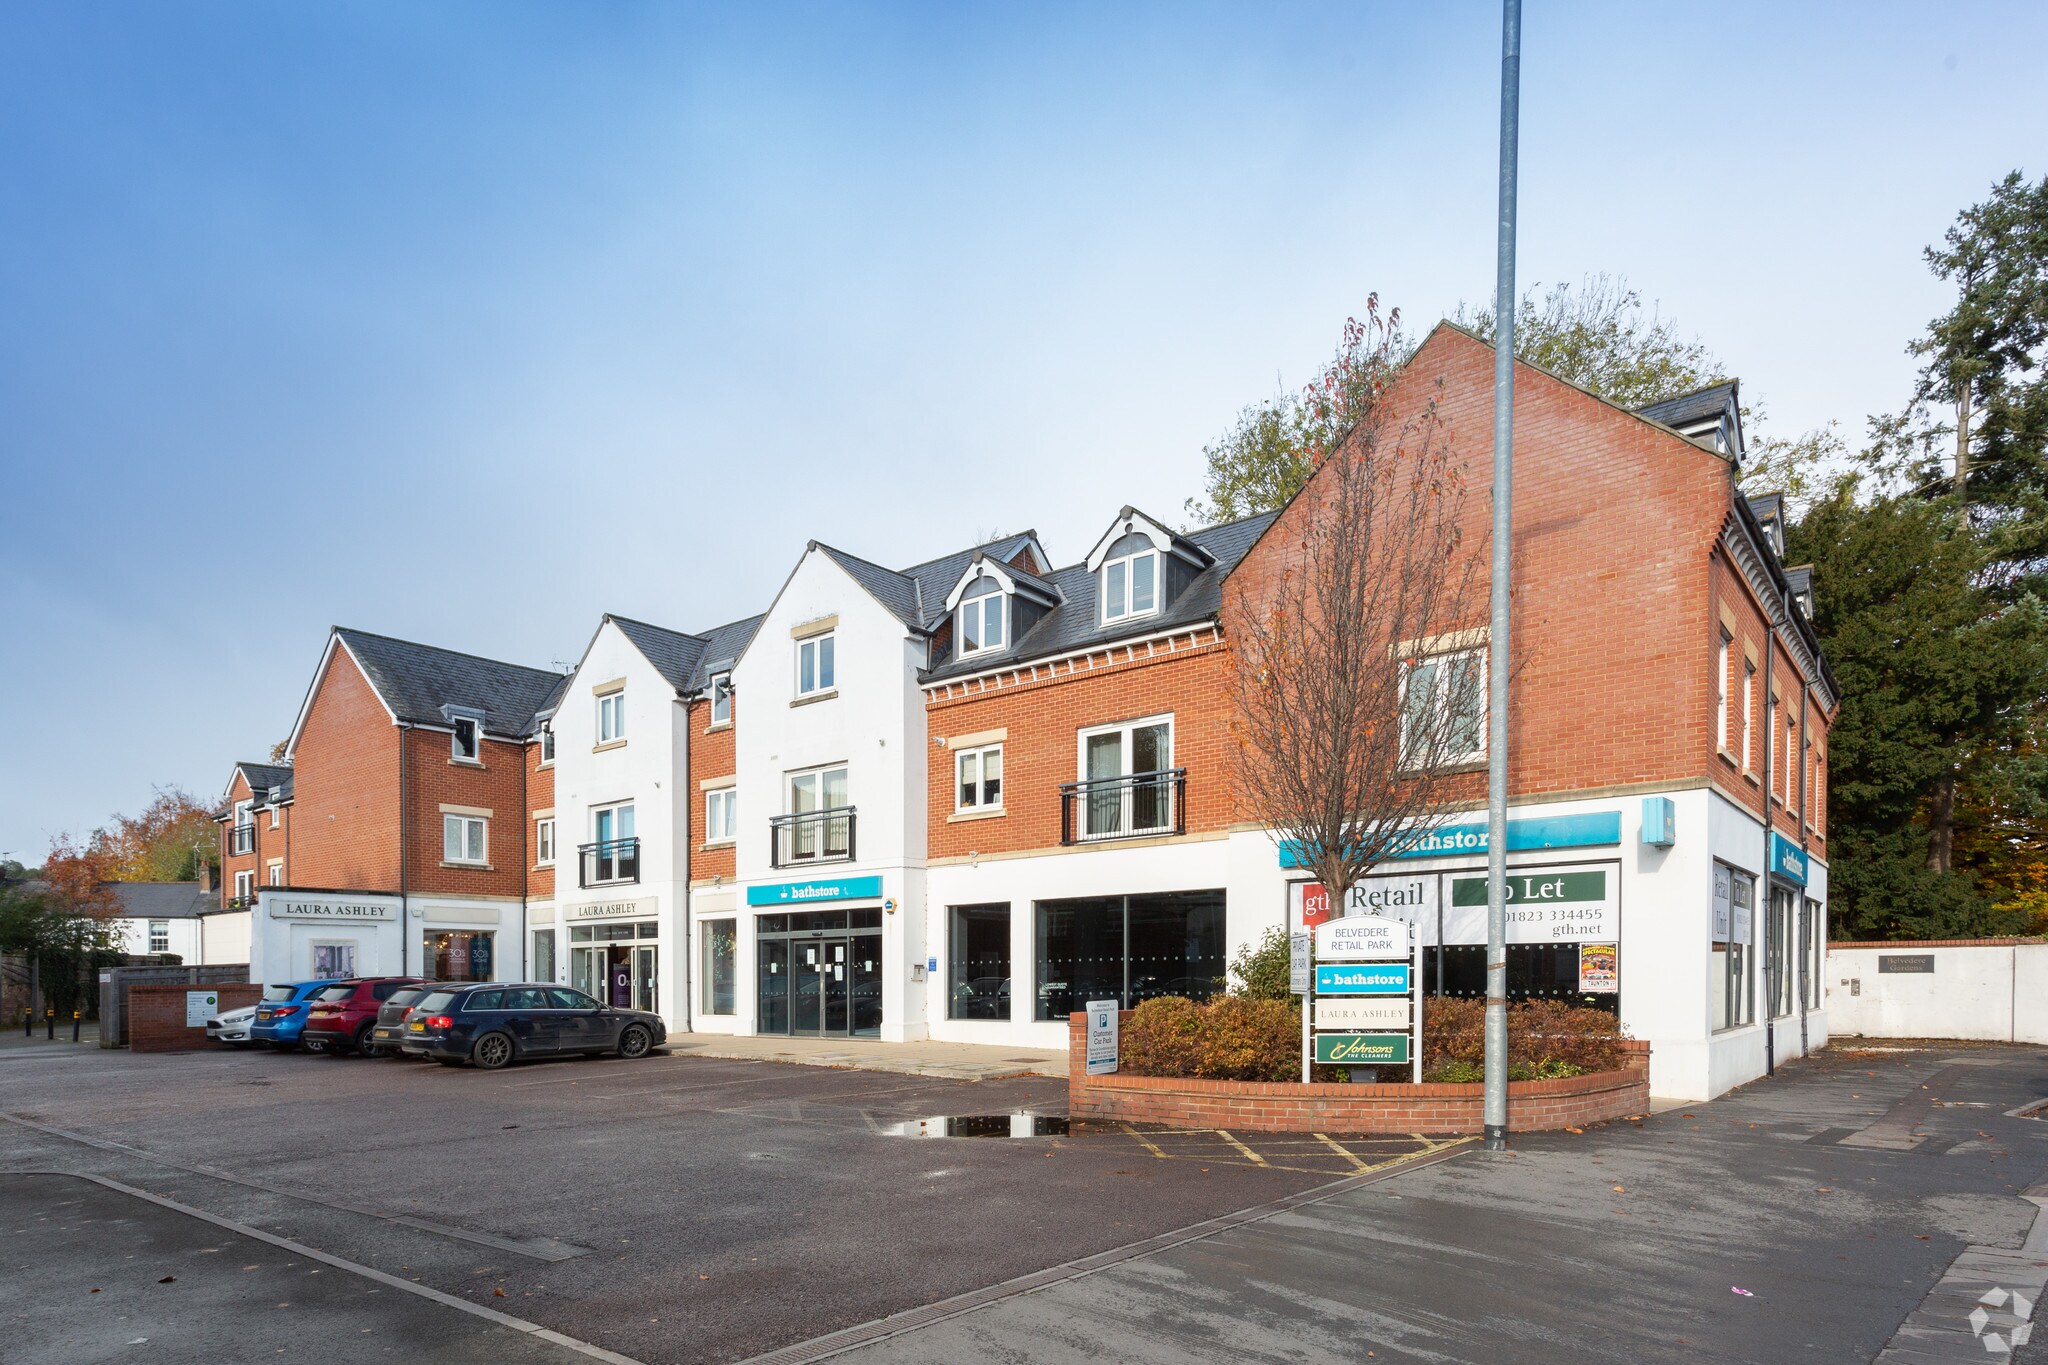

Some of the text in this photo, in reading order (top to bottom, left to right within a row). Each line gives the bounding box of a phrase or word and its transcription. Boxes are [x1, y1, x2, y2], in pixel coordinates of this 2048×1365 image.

[1390, 831, 1489, 853] bathstor
[791, 885, 840, 899] bathstore
[1351, 882, 1424, 908] Retail
[1484, 878, 1565, 900] o Let
[286, 904, 386, 916] LAURA ASHLEY
[579, 902, 637, 916] LAURA ASHLEY
[1549, 909, 1602, 921] 334455
[1335, 927, 1389, 938] BELVEDERE
[1552, 923, 1602, 938] gth.net
[1331, 940, 1393, 950] RETAIL PARK
[1334, 973, 1405, 985] bathstore
[1321, 1010, 1405, 1018] LAURA ASHLEY
[1092, 1030, 1113, 1038] Customer
[1330, 1037, 1394, 1060] Johnsons
